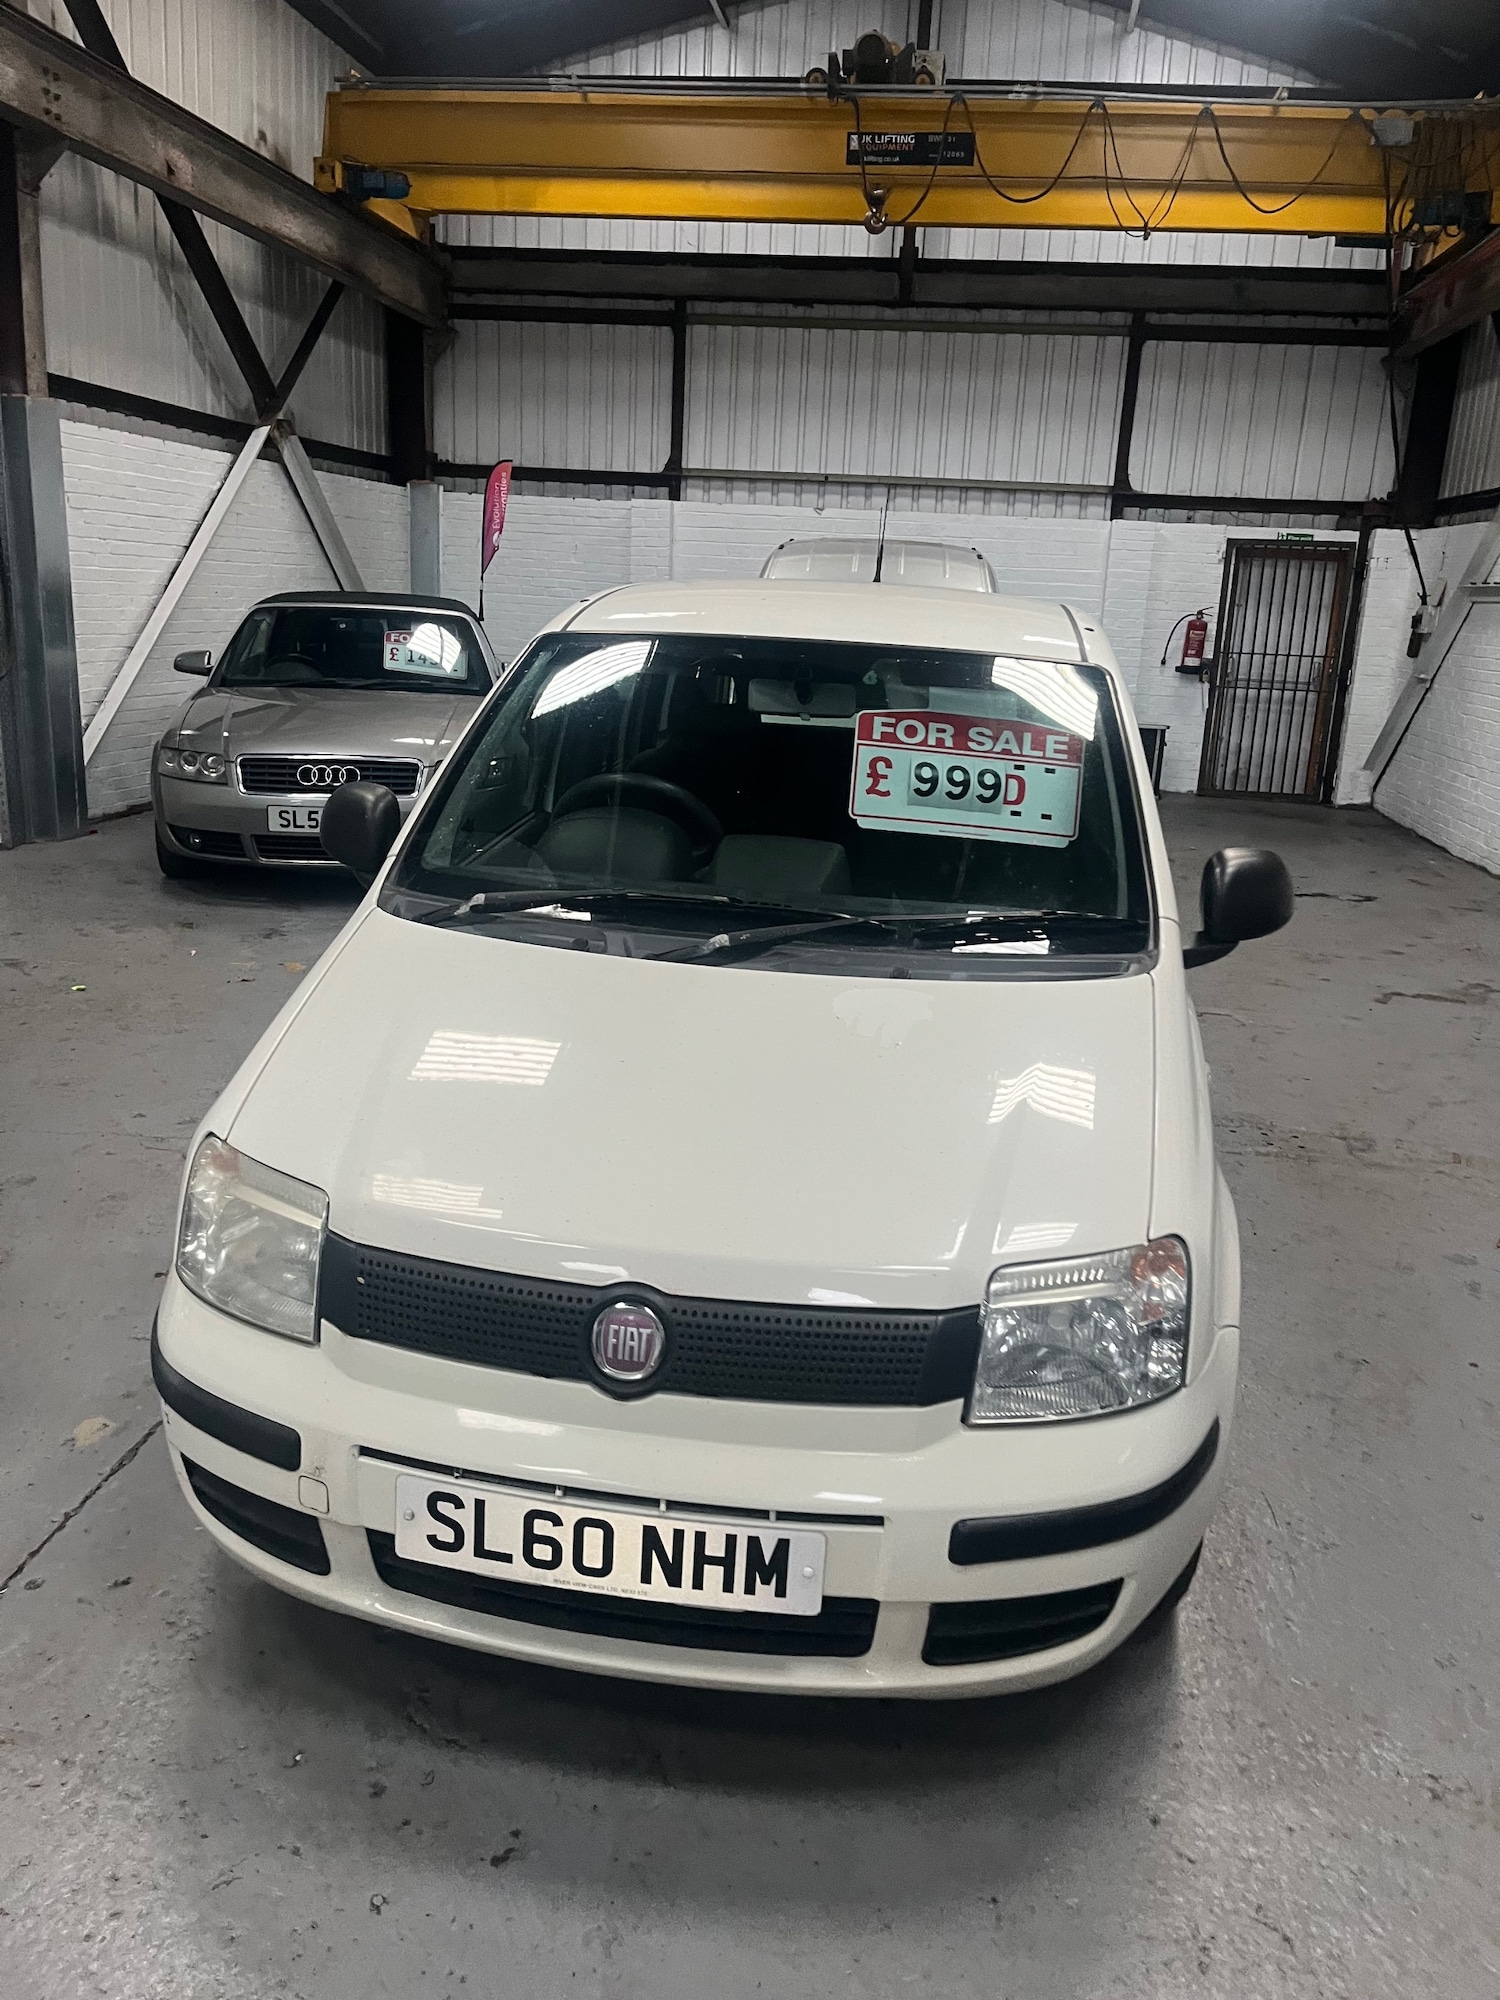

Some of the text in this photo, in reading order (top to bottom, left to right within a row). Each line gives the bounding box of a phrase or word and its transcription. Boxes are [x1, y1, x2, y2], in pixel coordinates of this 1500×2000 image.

[862, 135, 915, 143] JK LIFTING
[492, 482, 500, 529] Evolution
[500, 472, 508, 516] ranties
[389, 647, 400, 662] £
[390, 633, 411, 643] FO
[871, 716, 1070, 760] FOR SALE
[865, 756, 893, 797] £
[278, 810, 320, 829] SL5
[606, 1324, 652, 1362] FIAT
[426, 1490, 790, 1598] SL60 NHM
